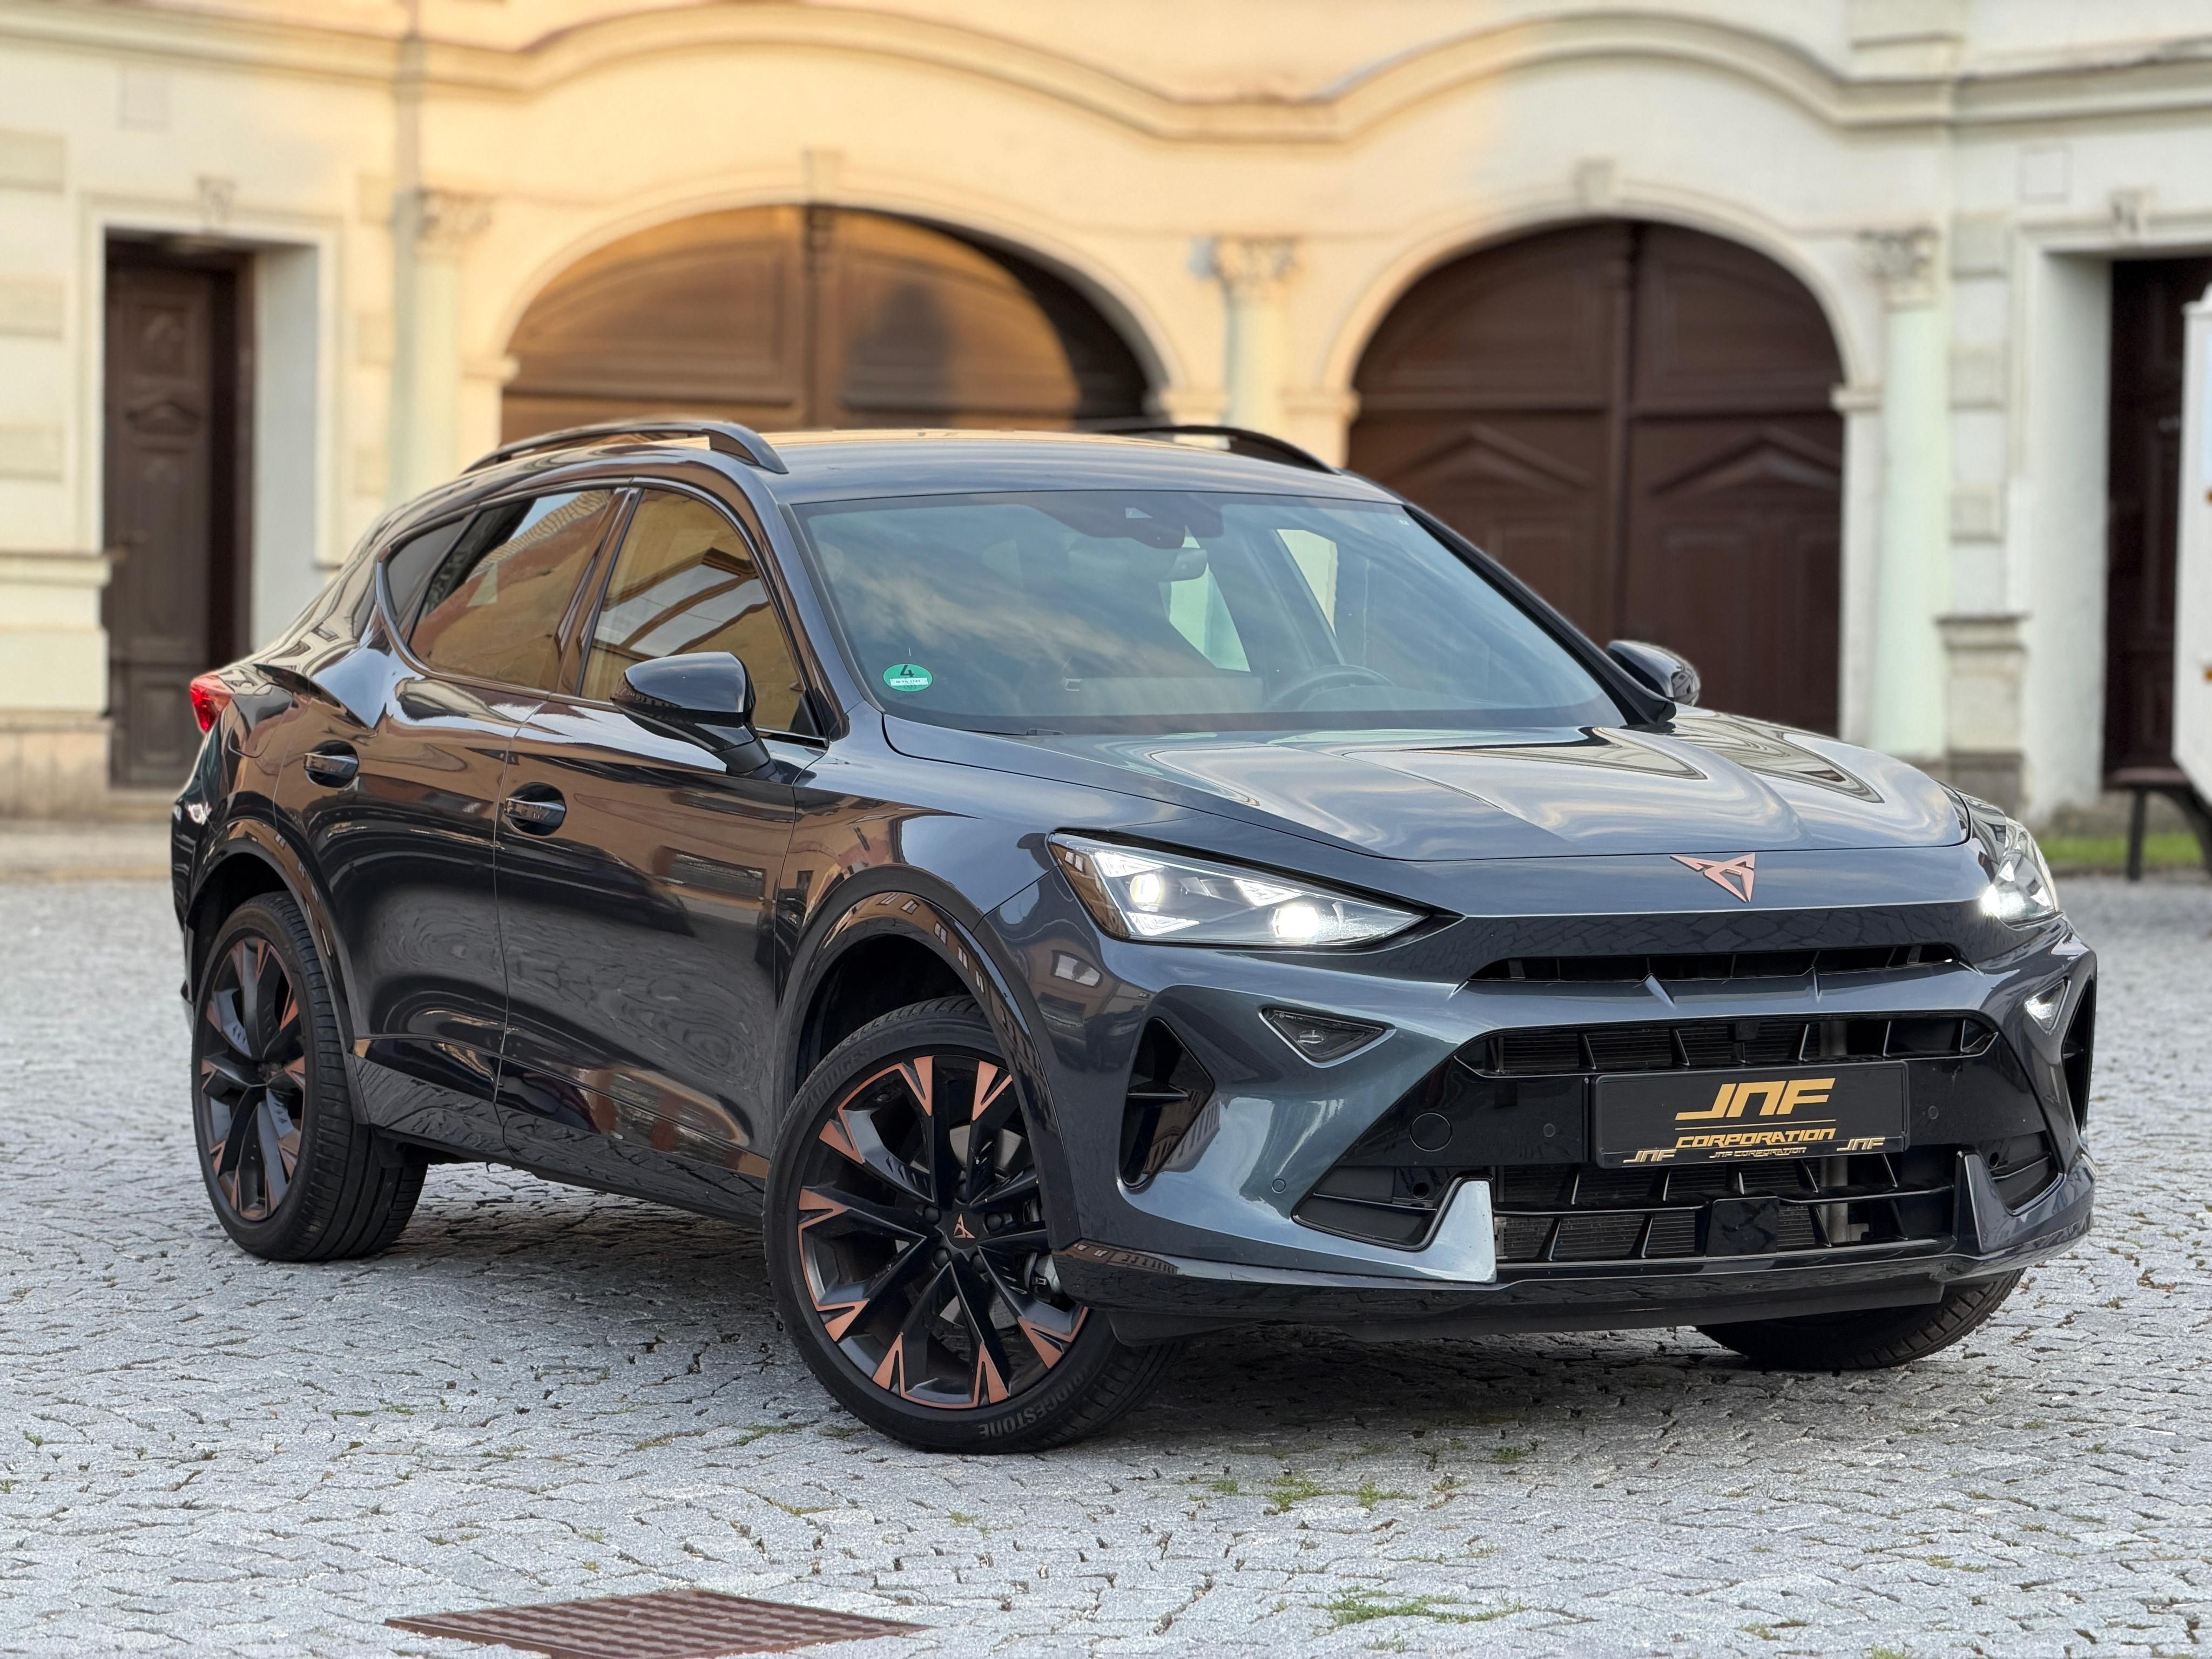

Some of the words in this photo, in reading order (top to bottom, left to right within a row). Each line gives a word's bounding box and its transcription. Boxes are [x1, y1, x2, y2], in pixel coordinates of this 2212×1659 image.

[900, 665, 914, 677] 4
[1675, 1078, 1836, 1121] JNF
[1675, 1128, 1836, 1149] CORPORATION
[1837, 1137, 1885, 1151] JNF
[1623, 1149, 1677, 1163] JNF
[1734, 1147, 1807, 1157] CORPORATION
